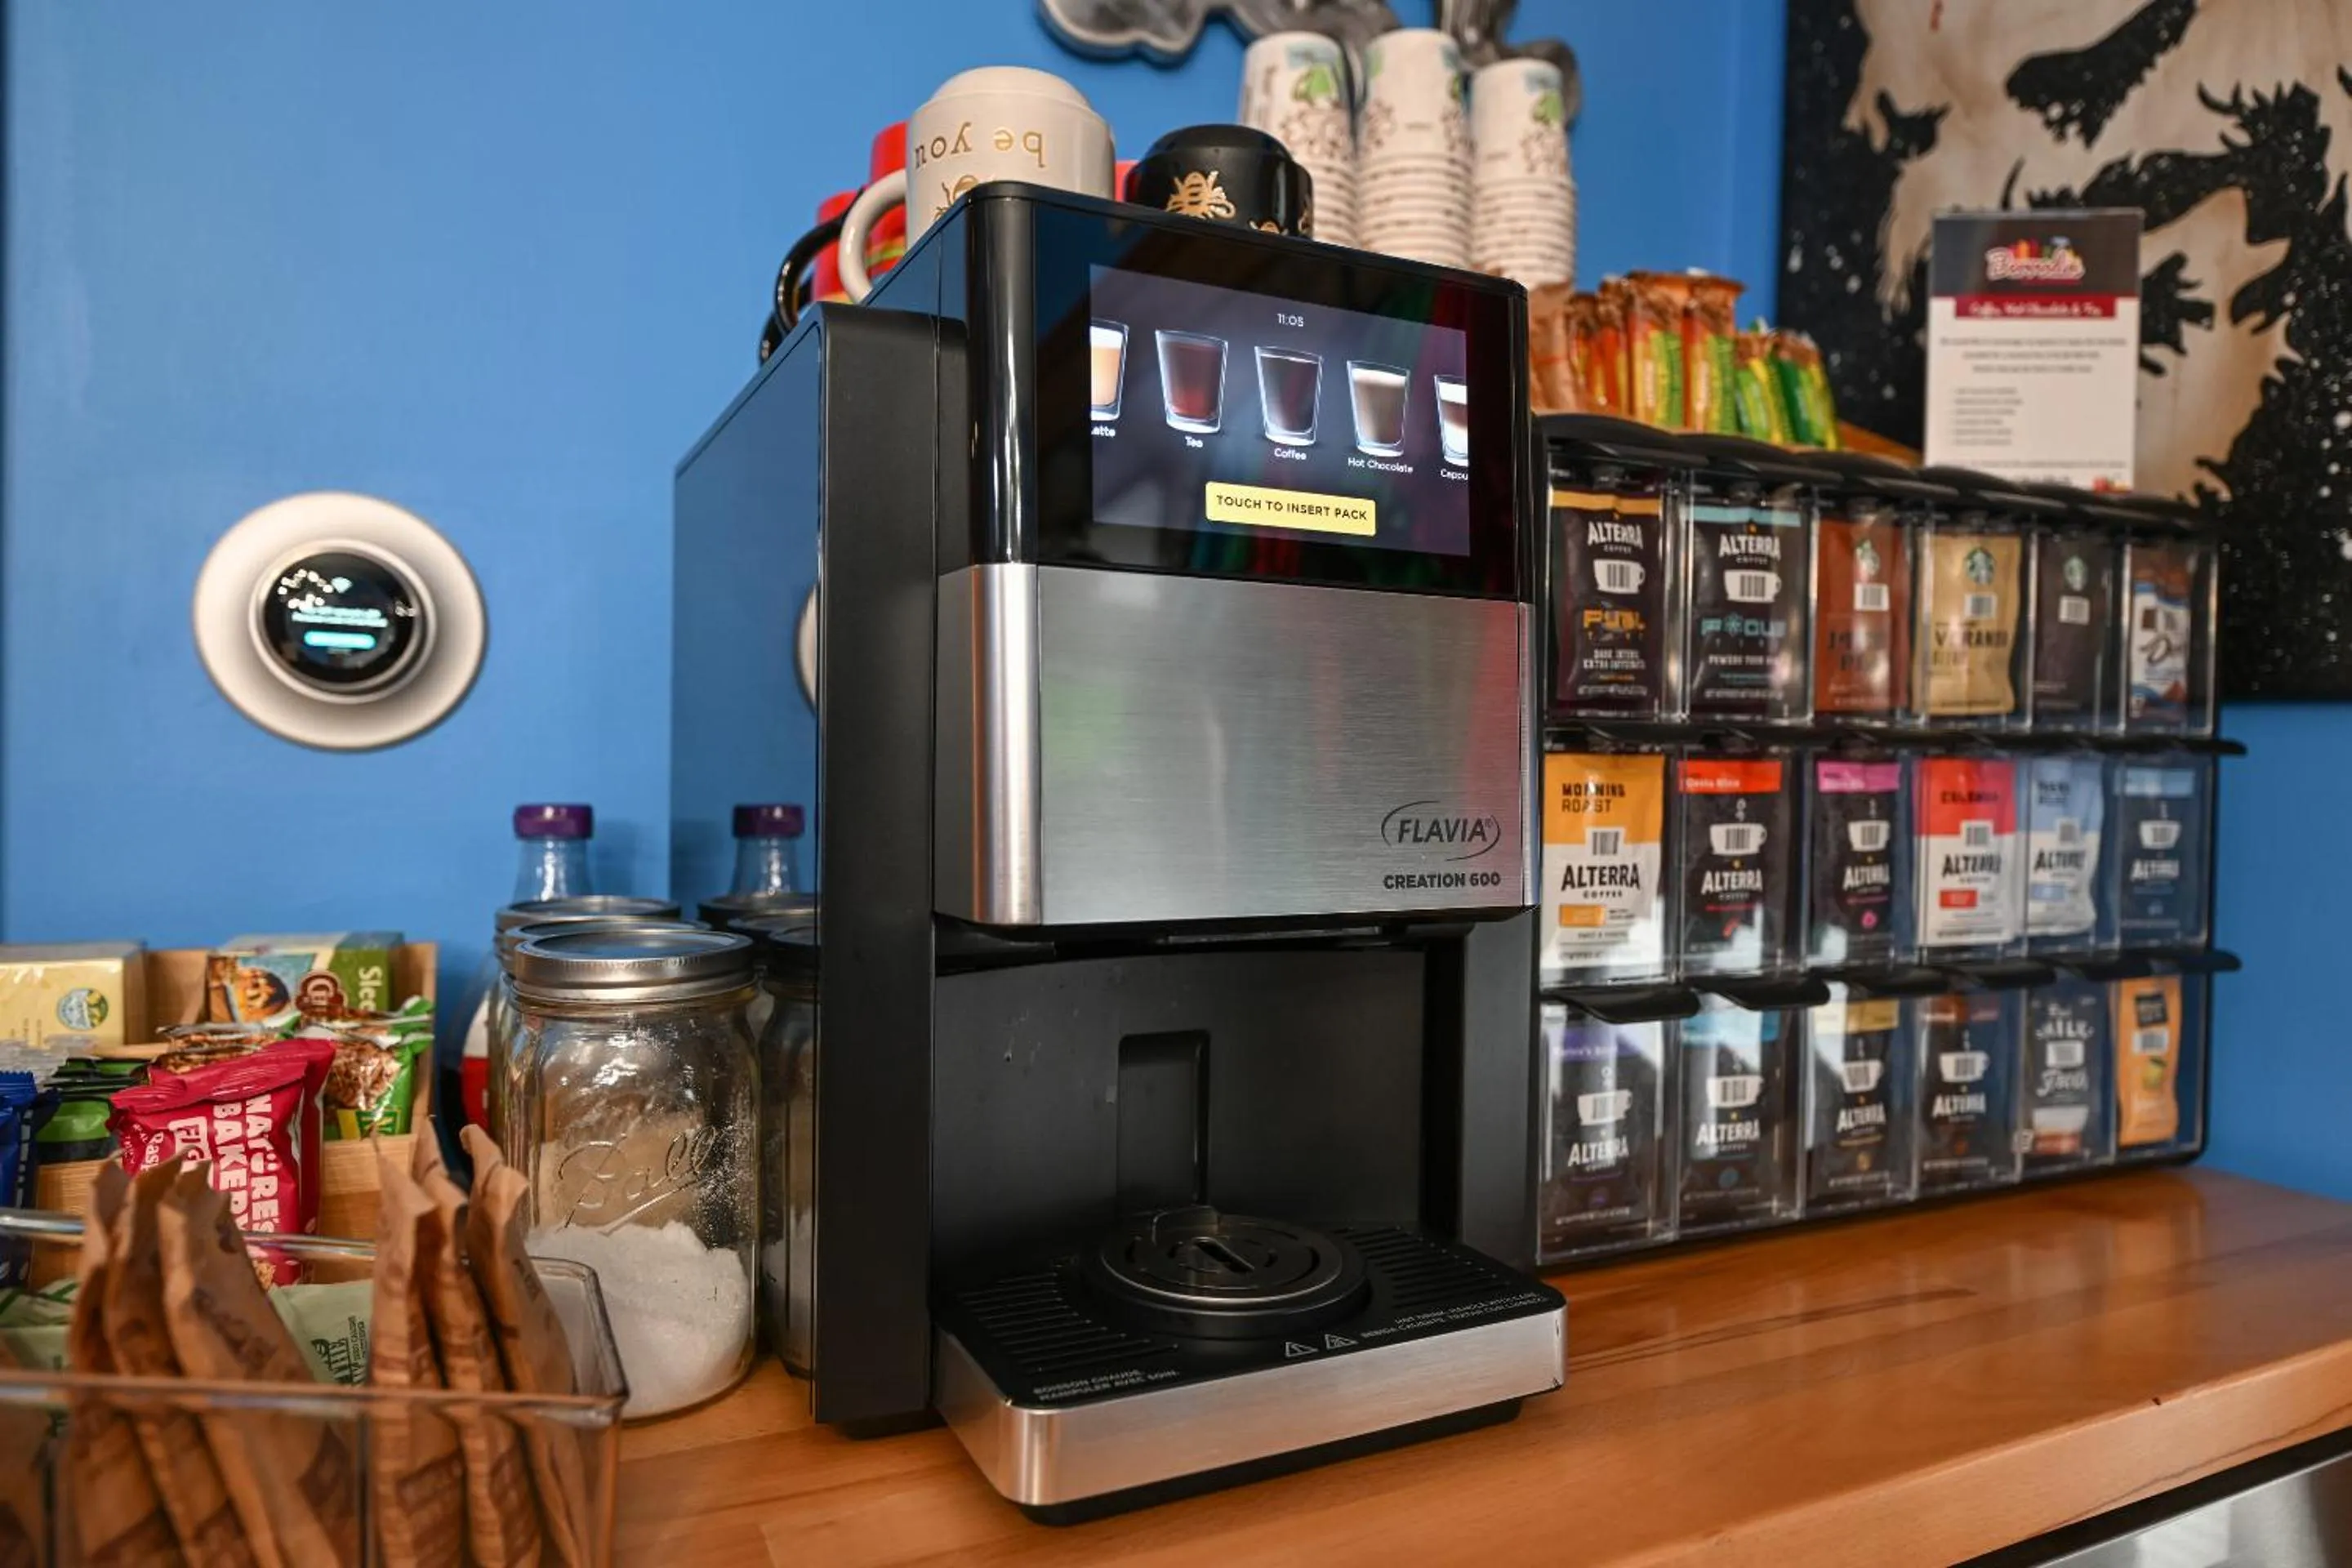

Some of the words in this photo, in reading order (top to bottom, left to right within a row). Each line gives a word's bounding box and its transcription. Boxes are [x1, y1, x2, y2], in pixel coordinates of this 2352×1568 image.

[1091, 425, 1116, 439] atte
[1185, 435, 1204, 448] Tea
[1274, 448, 1307, 461] Coffee
[1348, 457, 1365, 470] Hot
[1367, 459, 1414, 474] Chocolate
[1217, 494, 1263, 512] TOUCH
[1265, 500, 1285, 512] TO
[1286, 501, 1332, 518] INSERT
[1334, 506, 1368, 522] PACK
[1587, 521, 1644, 549] ALTERRA
[1718, 533, 1782, 561] ALTERRA
[1397, 817, 1488, 844] FLAVIA
[1383, 871, 1466, 890] CREATION
[1468, 871, 1501, 887] 600
[1561, 863, 1641, 892] ALTERRA
[1701, 868, 1763, 895] ALTERRA
